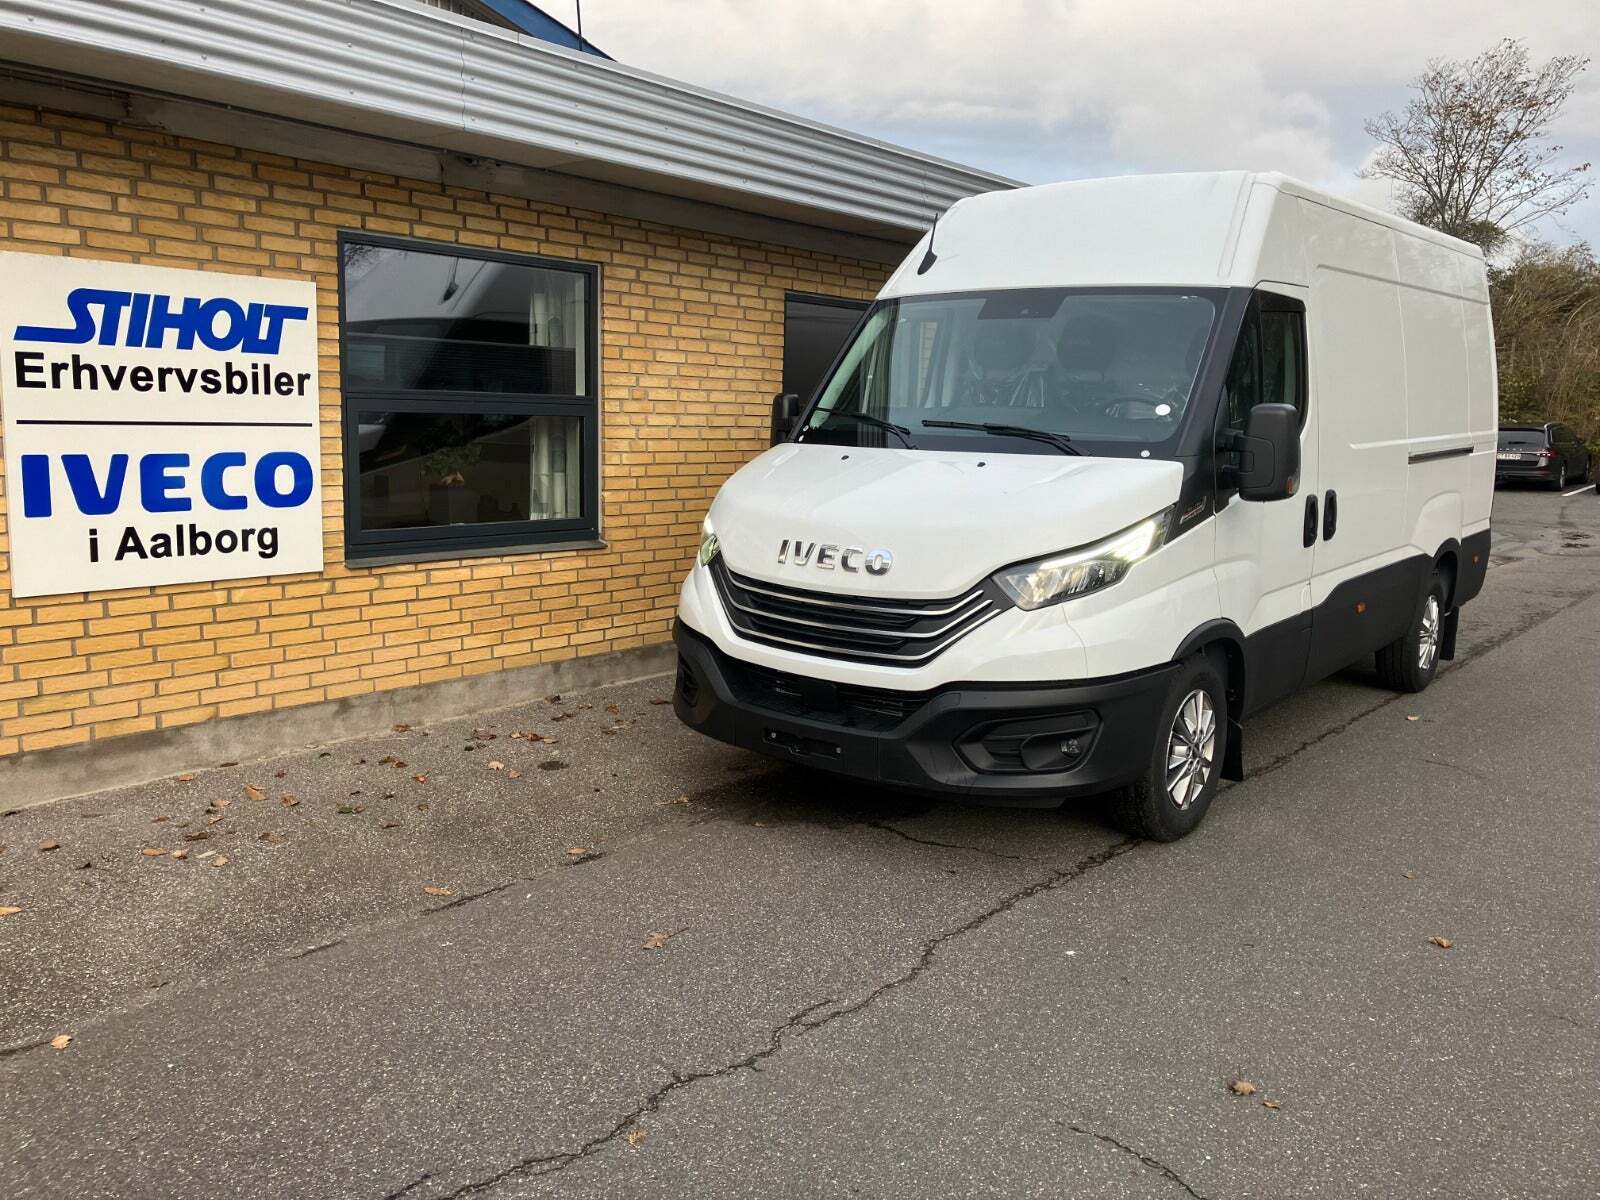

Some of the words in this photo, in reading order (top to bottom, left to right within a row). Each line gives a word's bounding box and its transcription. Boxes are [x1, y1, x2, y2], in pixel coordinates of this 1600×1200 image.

[14, 288, 309, 355] STIHOLT
[14, 351, 311, 396] Erhvervsbiler
[21, 451, 314, 518] IVECO
[88, 528, 99, 563] i
[114, 523, 279, 561] Aalborg
[777, 538, 894, 576] IVECO
